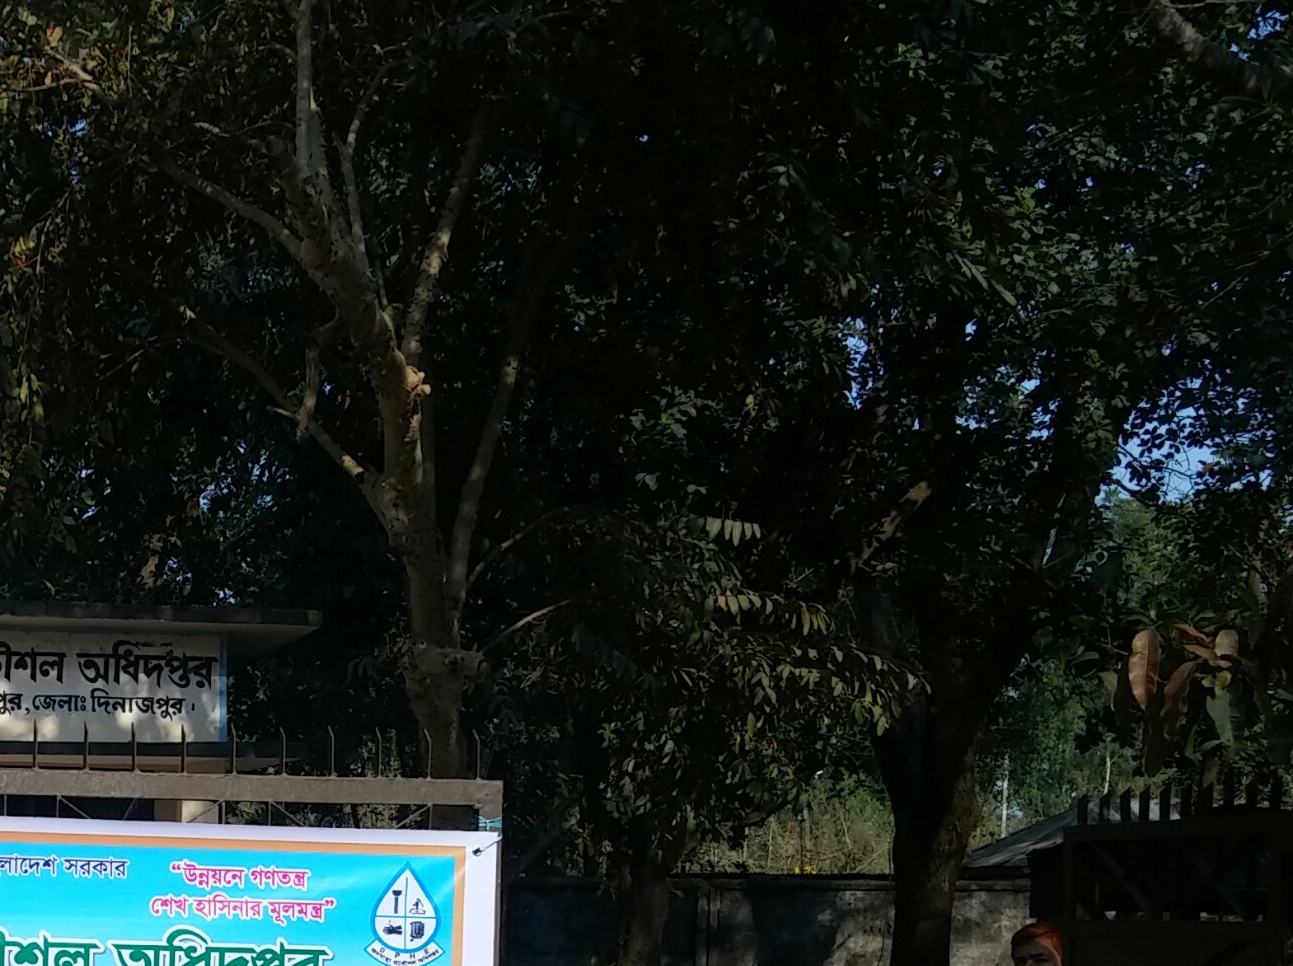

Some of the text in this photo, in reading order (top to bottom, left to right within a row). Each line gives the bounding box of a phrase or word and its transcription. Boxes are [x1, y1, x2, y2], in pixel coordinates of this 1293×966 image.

[76, 640, 218, 690] অধিদপ্তর
[64, 858, 128, 878] সরকার
[250, 866, 309, 889] গণতন্ত্র
[152, 896, 188, 915] শেখ
[193, 894, 263, 918] হাসিনার
